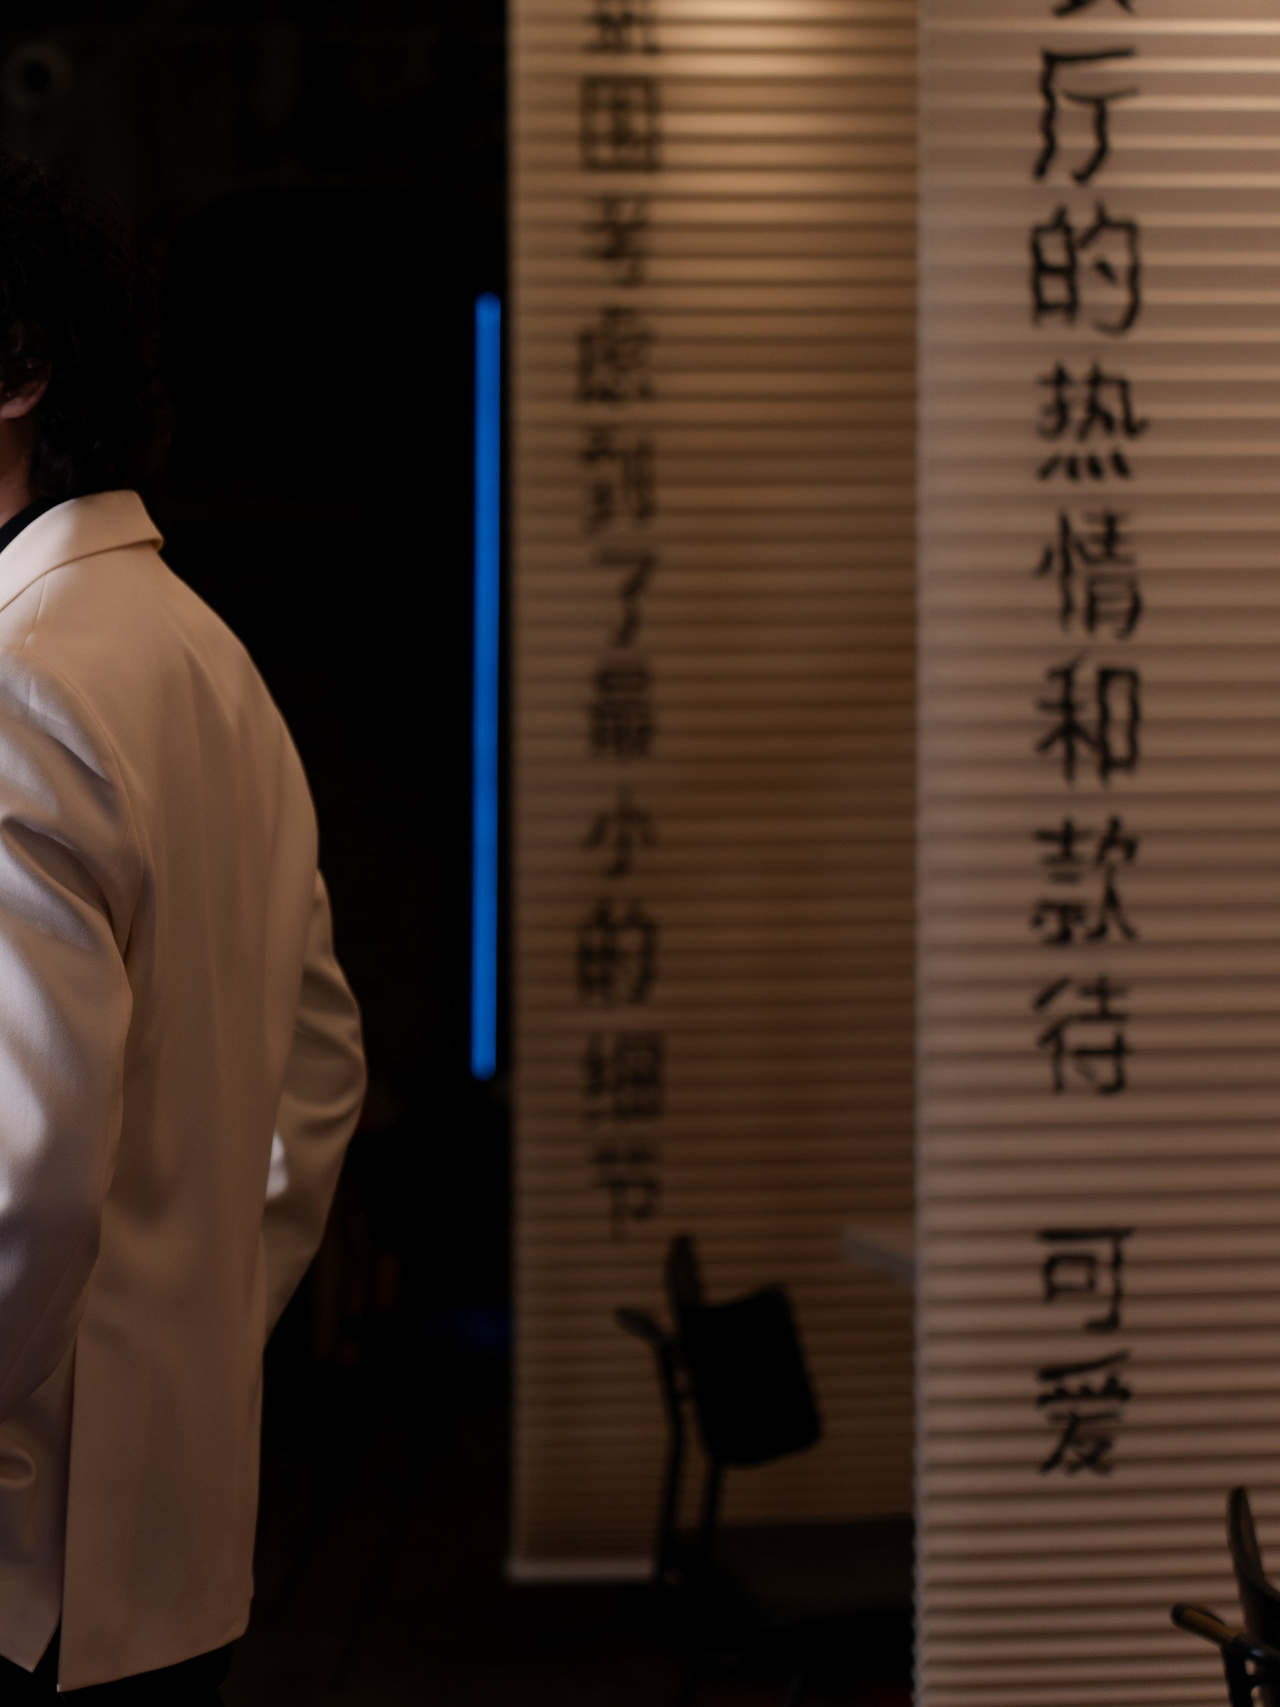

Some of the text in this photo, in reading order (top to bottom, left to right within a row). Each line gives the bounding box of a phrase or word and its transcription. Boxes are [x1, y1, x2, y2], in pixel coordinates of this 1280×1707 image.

[1030, 0, 1148, 1478] 厅的热情和款待 可爱
